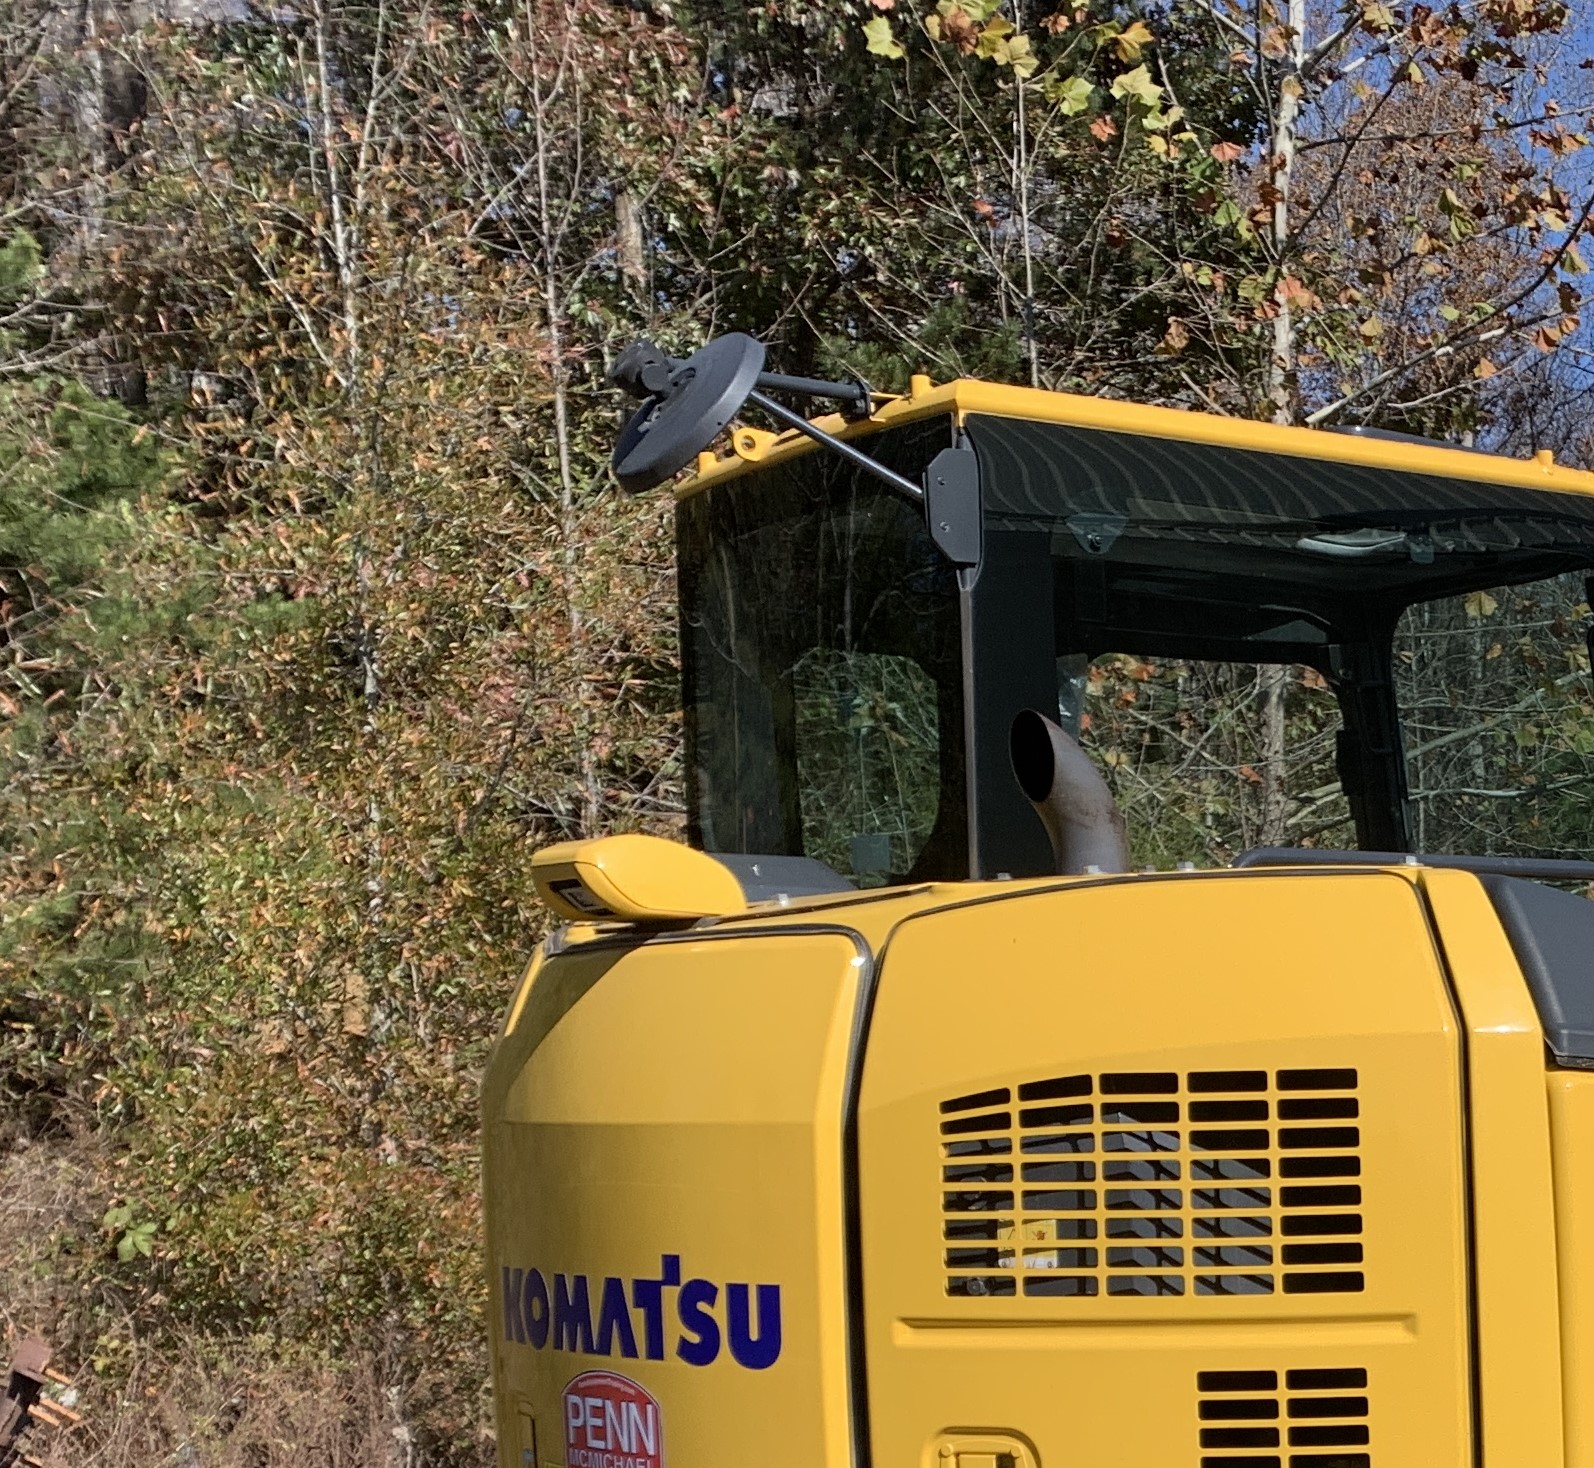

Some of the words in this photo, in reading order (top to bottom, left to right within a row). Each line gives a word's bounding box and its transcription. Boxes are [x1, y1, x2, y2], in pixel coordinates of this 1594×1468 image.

[653, 232, 892, 391] KOMATSU
[502, 1254, 782, 1370] KOMATSU
[566, 1394, 656, 1456] PENN
